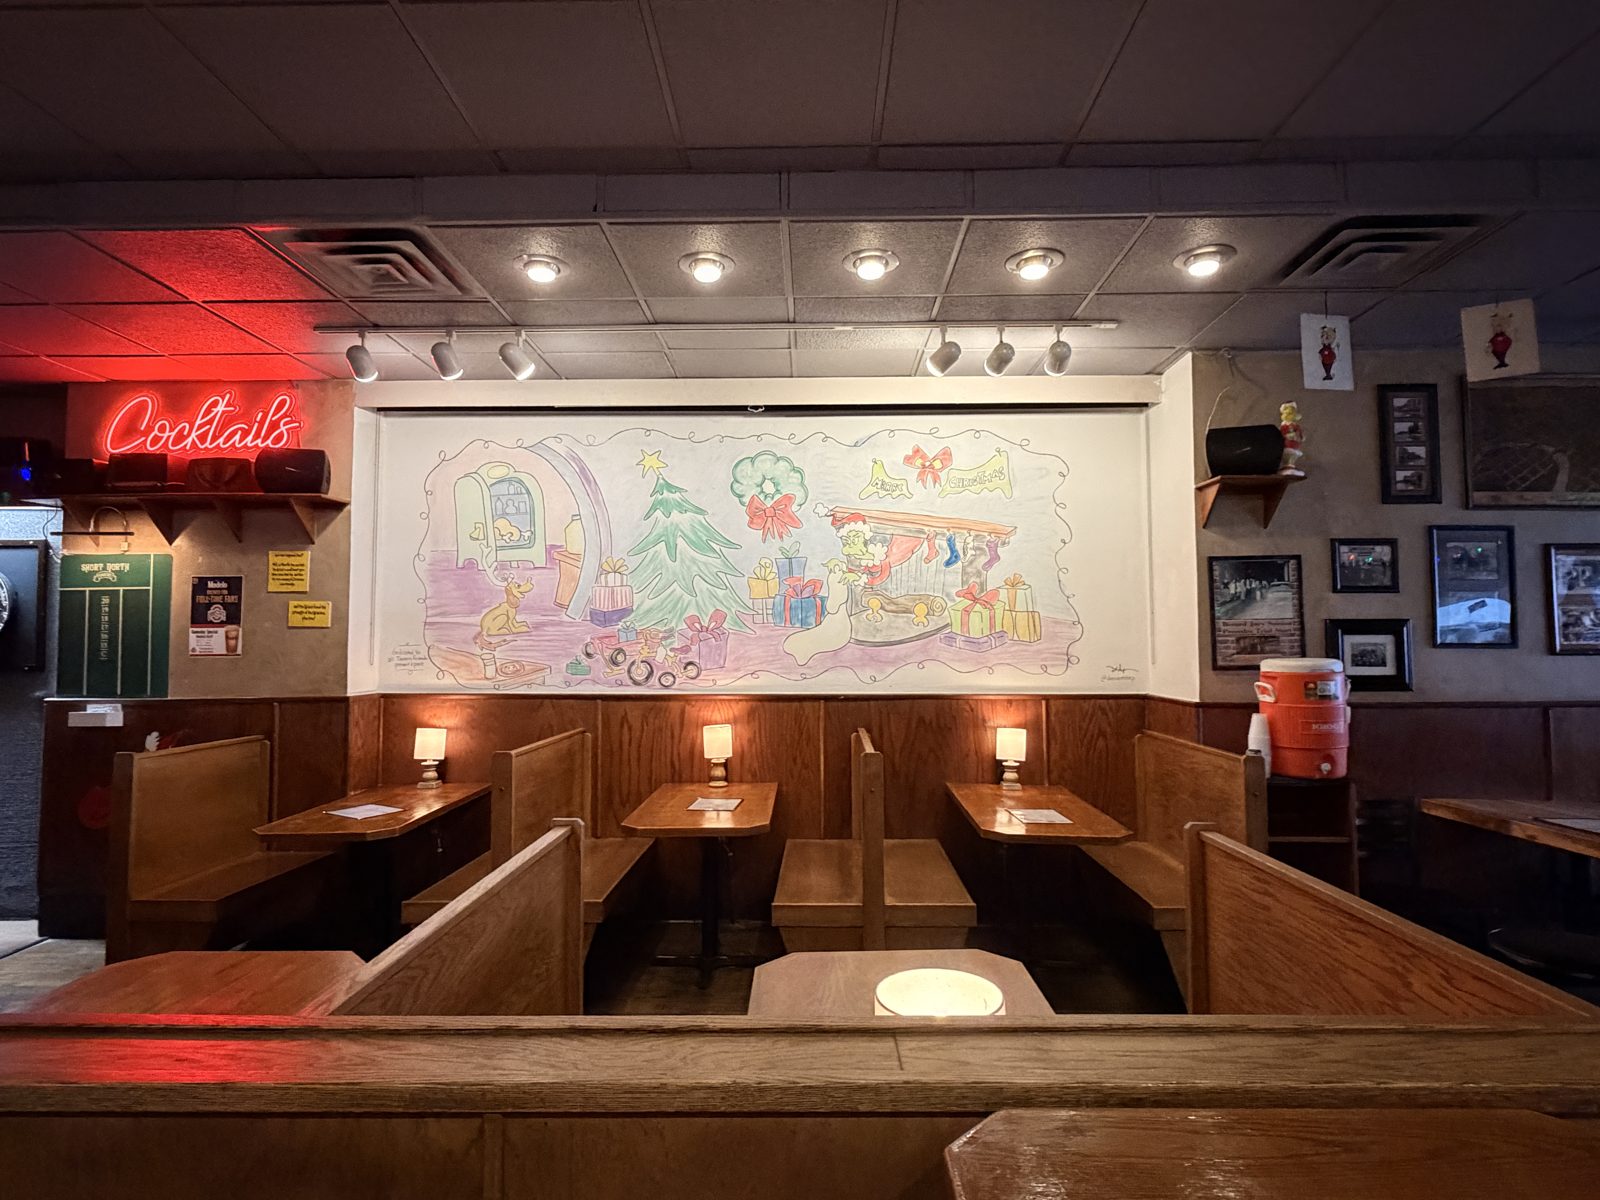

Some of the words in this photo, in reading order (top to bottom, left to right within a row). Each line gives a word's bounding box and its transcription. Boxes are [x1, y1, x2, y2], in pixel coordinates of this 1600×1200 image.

[106, 392, 300, 454] Cocktails
[870, 476, 904, 492] MERRY
[948, 465, 1006, 489] CHRISTMAS
[207, 580, 228, 588] Modelo
